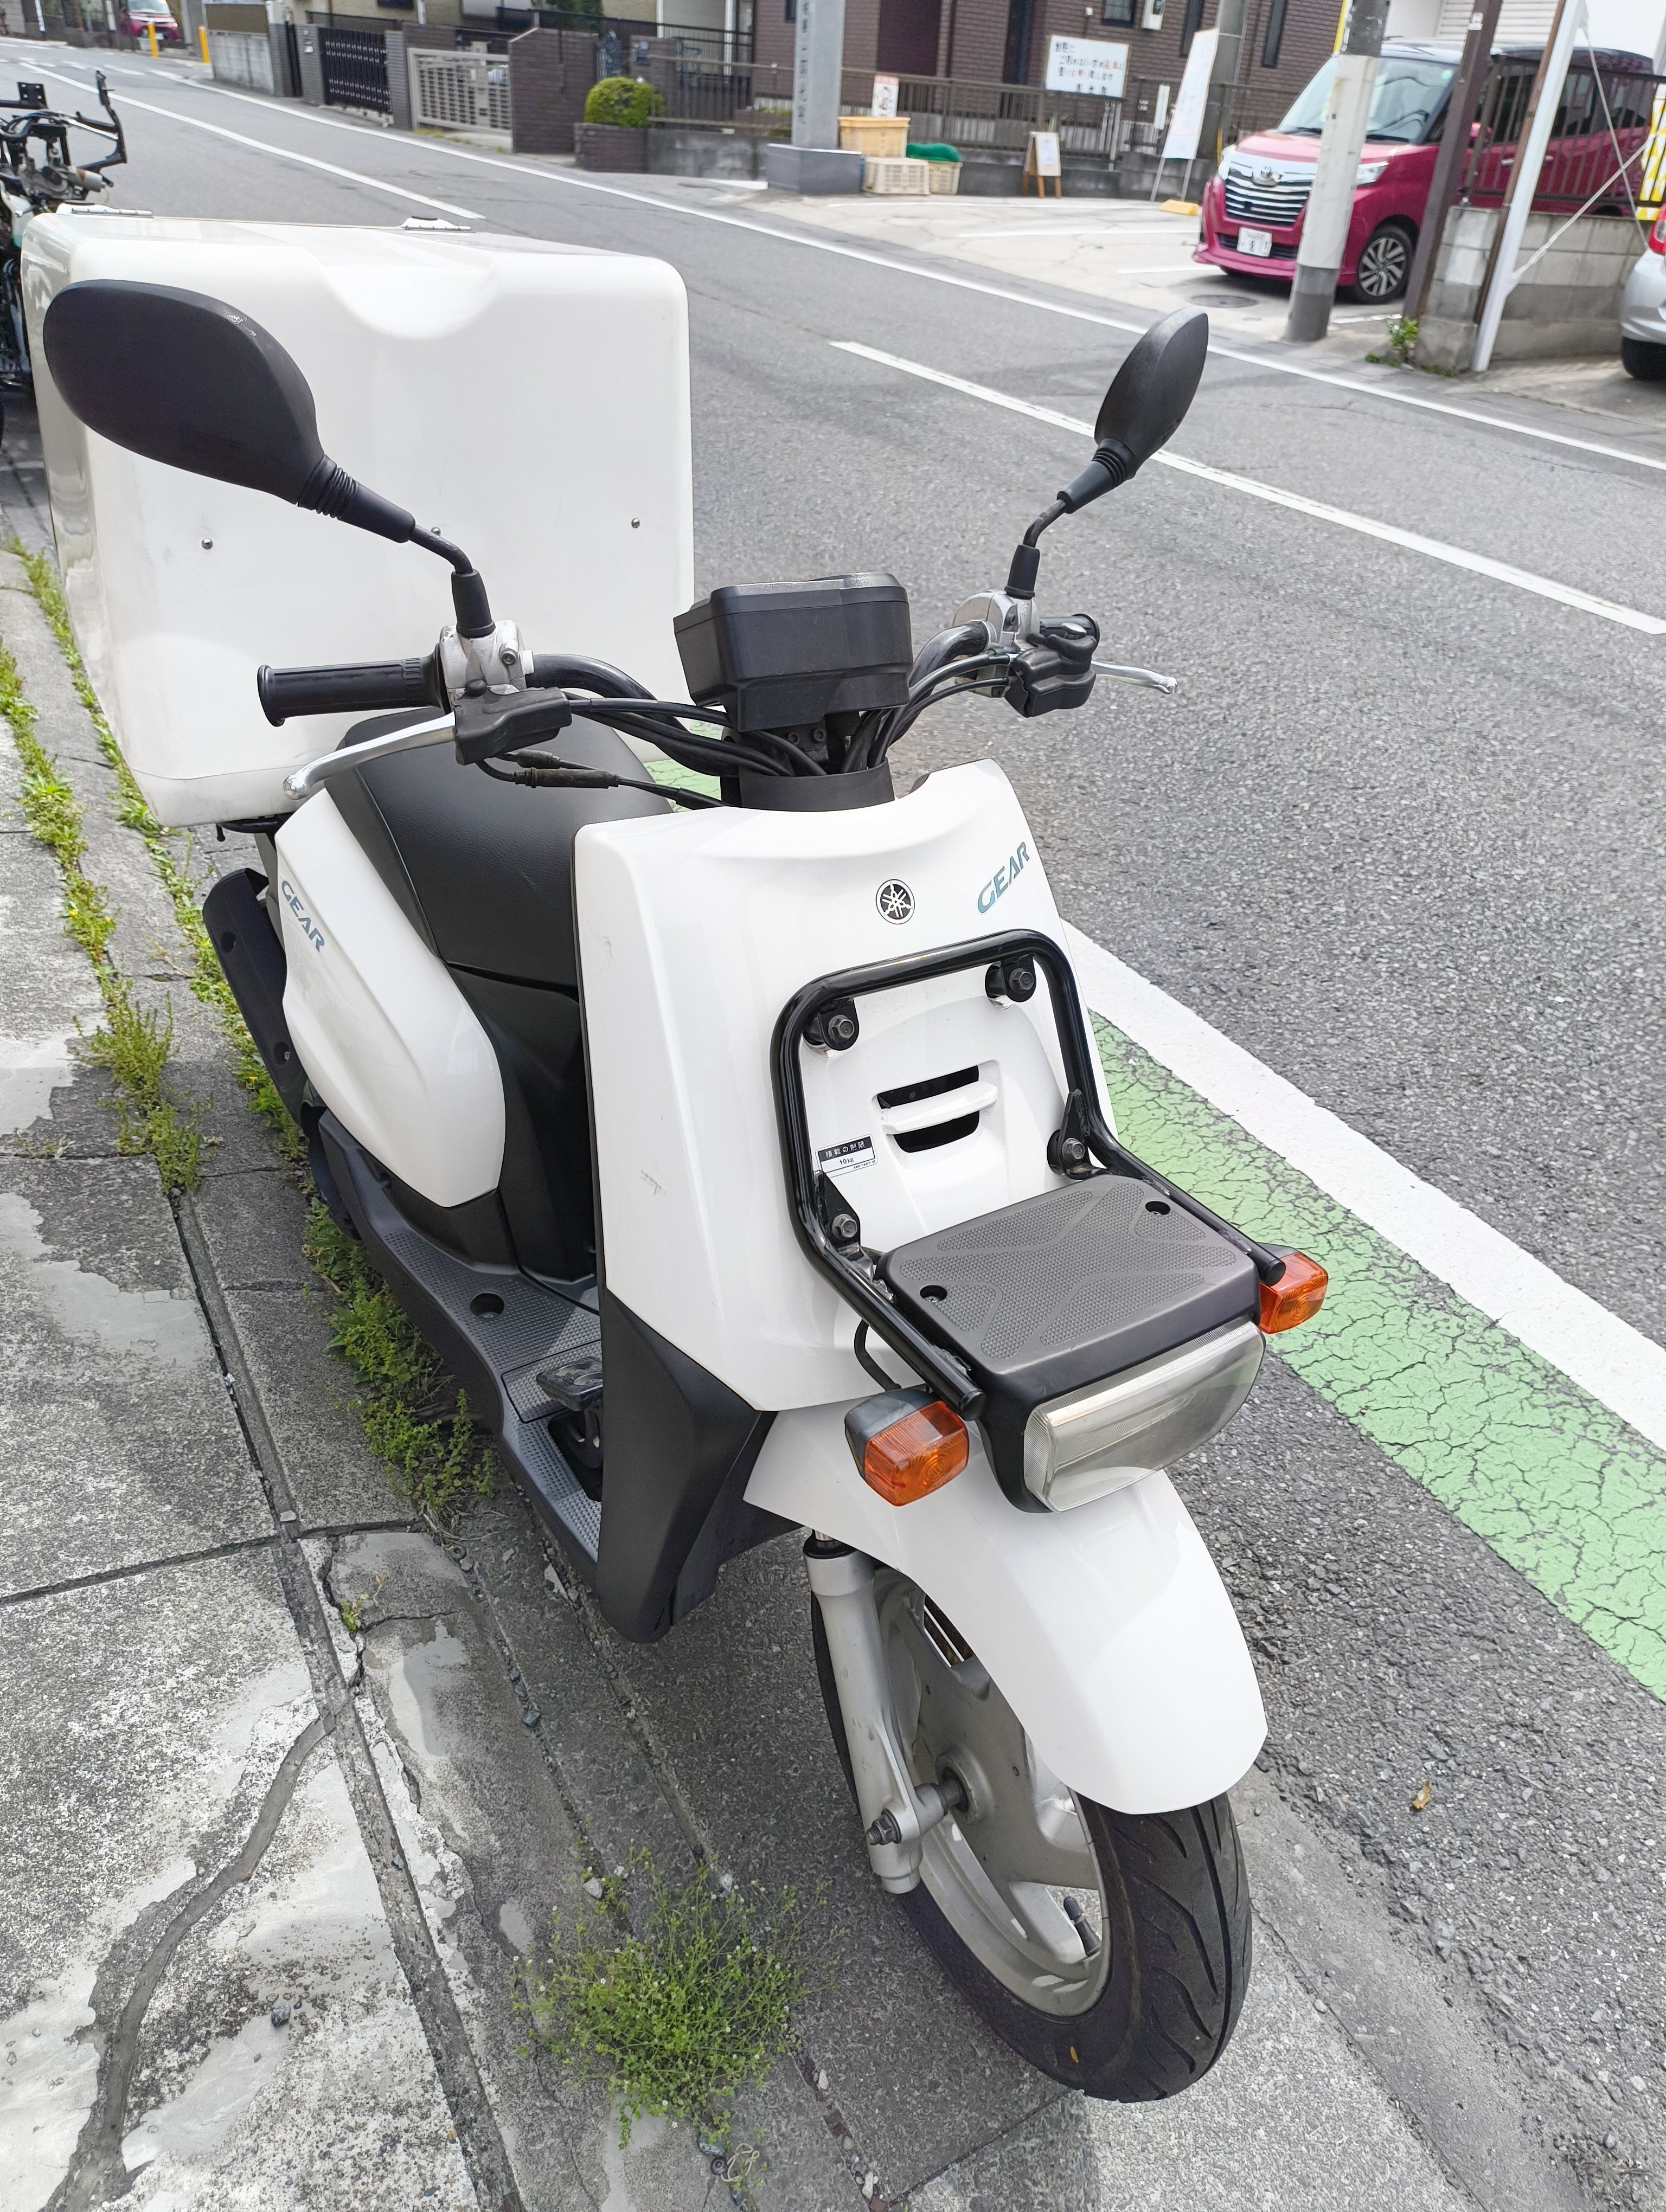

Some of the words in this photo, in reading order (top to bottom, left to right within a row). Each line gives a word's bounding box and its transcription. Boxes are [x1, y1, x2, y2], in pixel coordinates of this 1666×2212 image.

[977, 842, 1030, 914] GEAR
[281, 880, 325, 953] GEAR
[825, 1140, 866, 1158] 積載の制限
